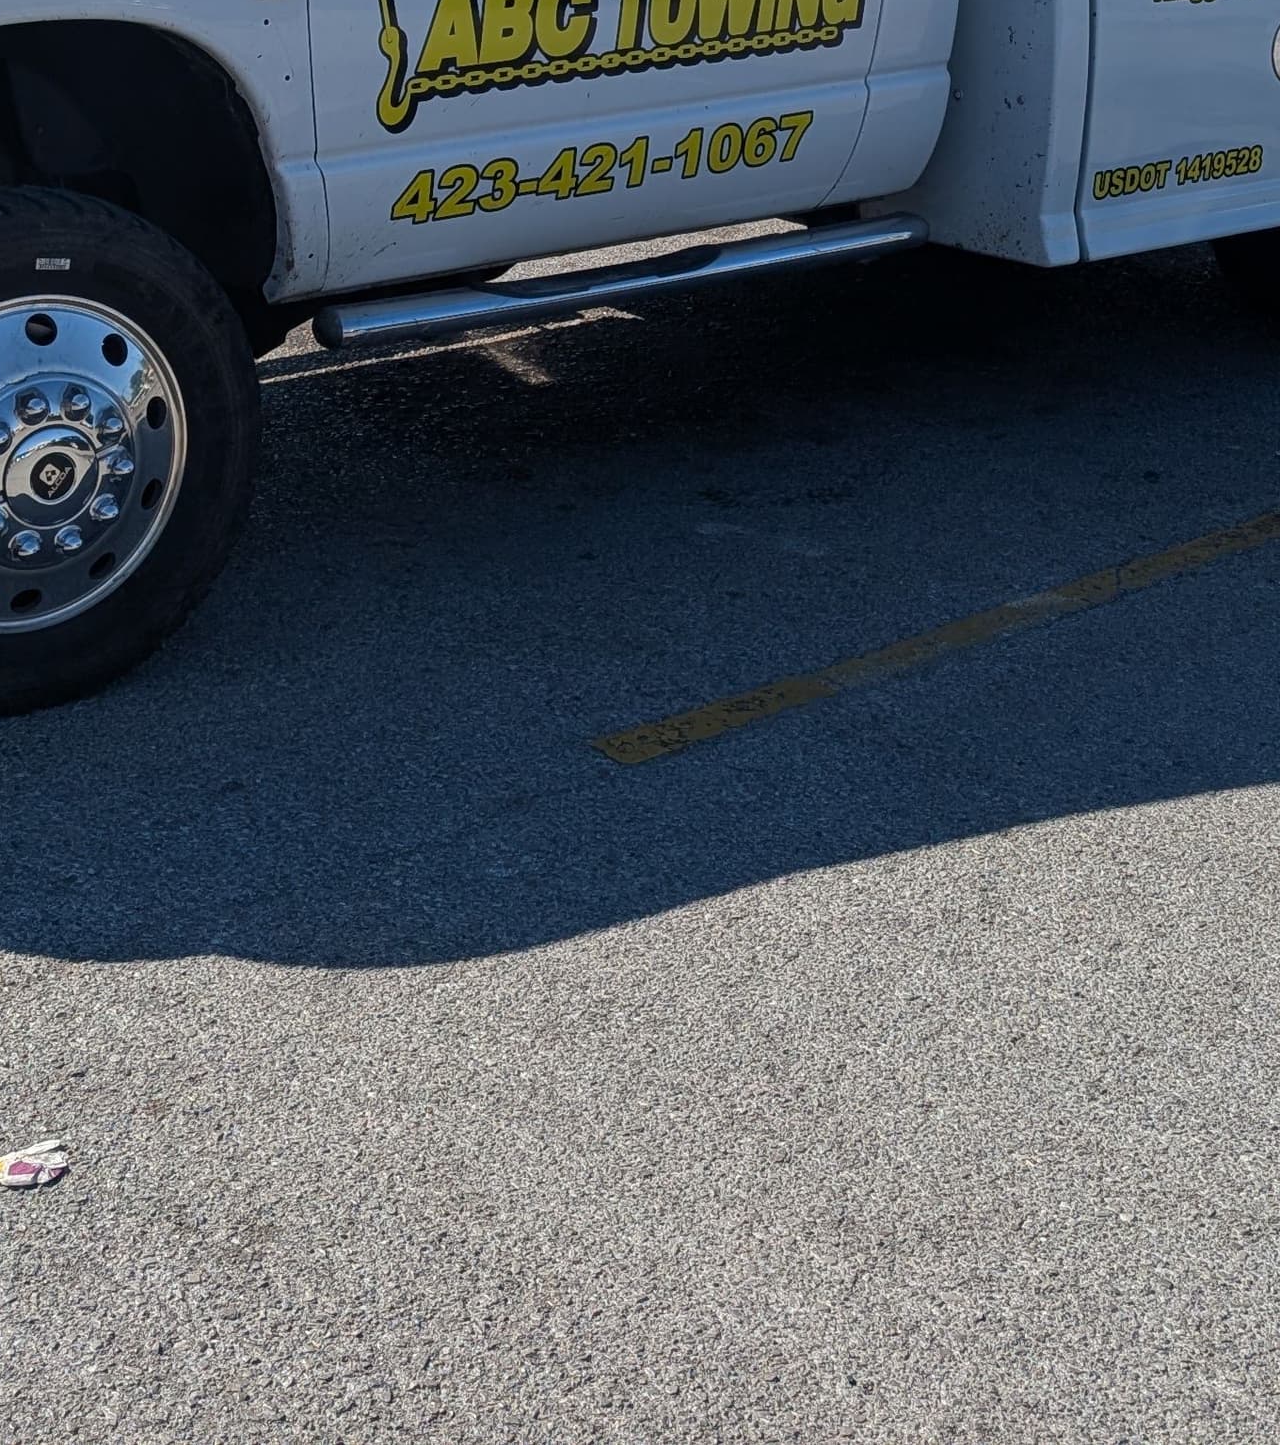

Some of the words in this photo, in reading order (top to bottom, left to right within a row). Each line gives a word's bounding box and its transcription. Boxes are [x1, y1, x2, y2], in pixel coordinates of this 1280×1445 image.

[390, 110, 815, 224] 423-421-1067
[1093, 159, 1172, 200] USDOT
[1175, 145, 1263, 185] 1419528
[47, 466, 73, 499] ALCOA
